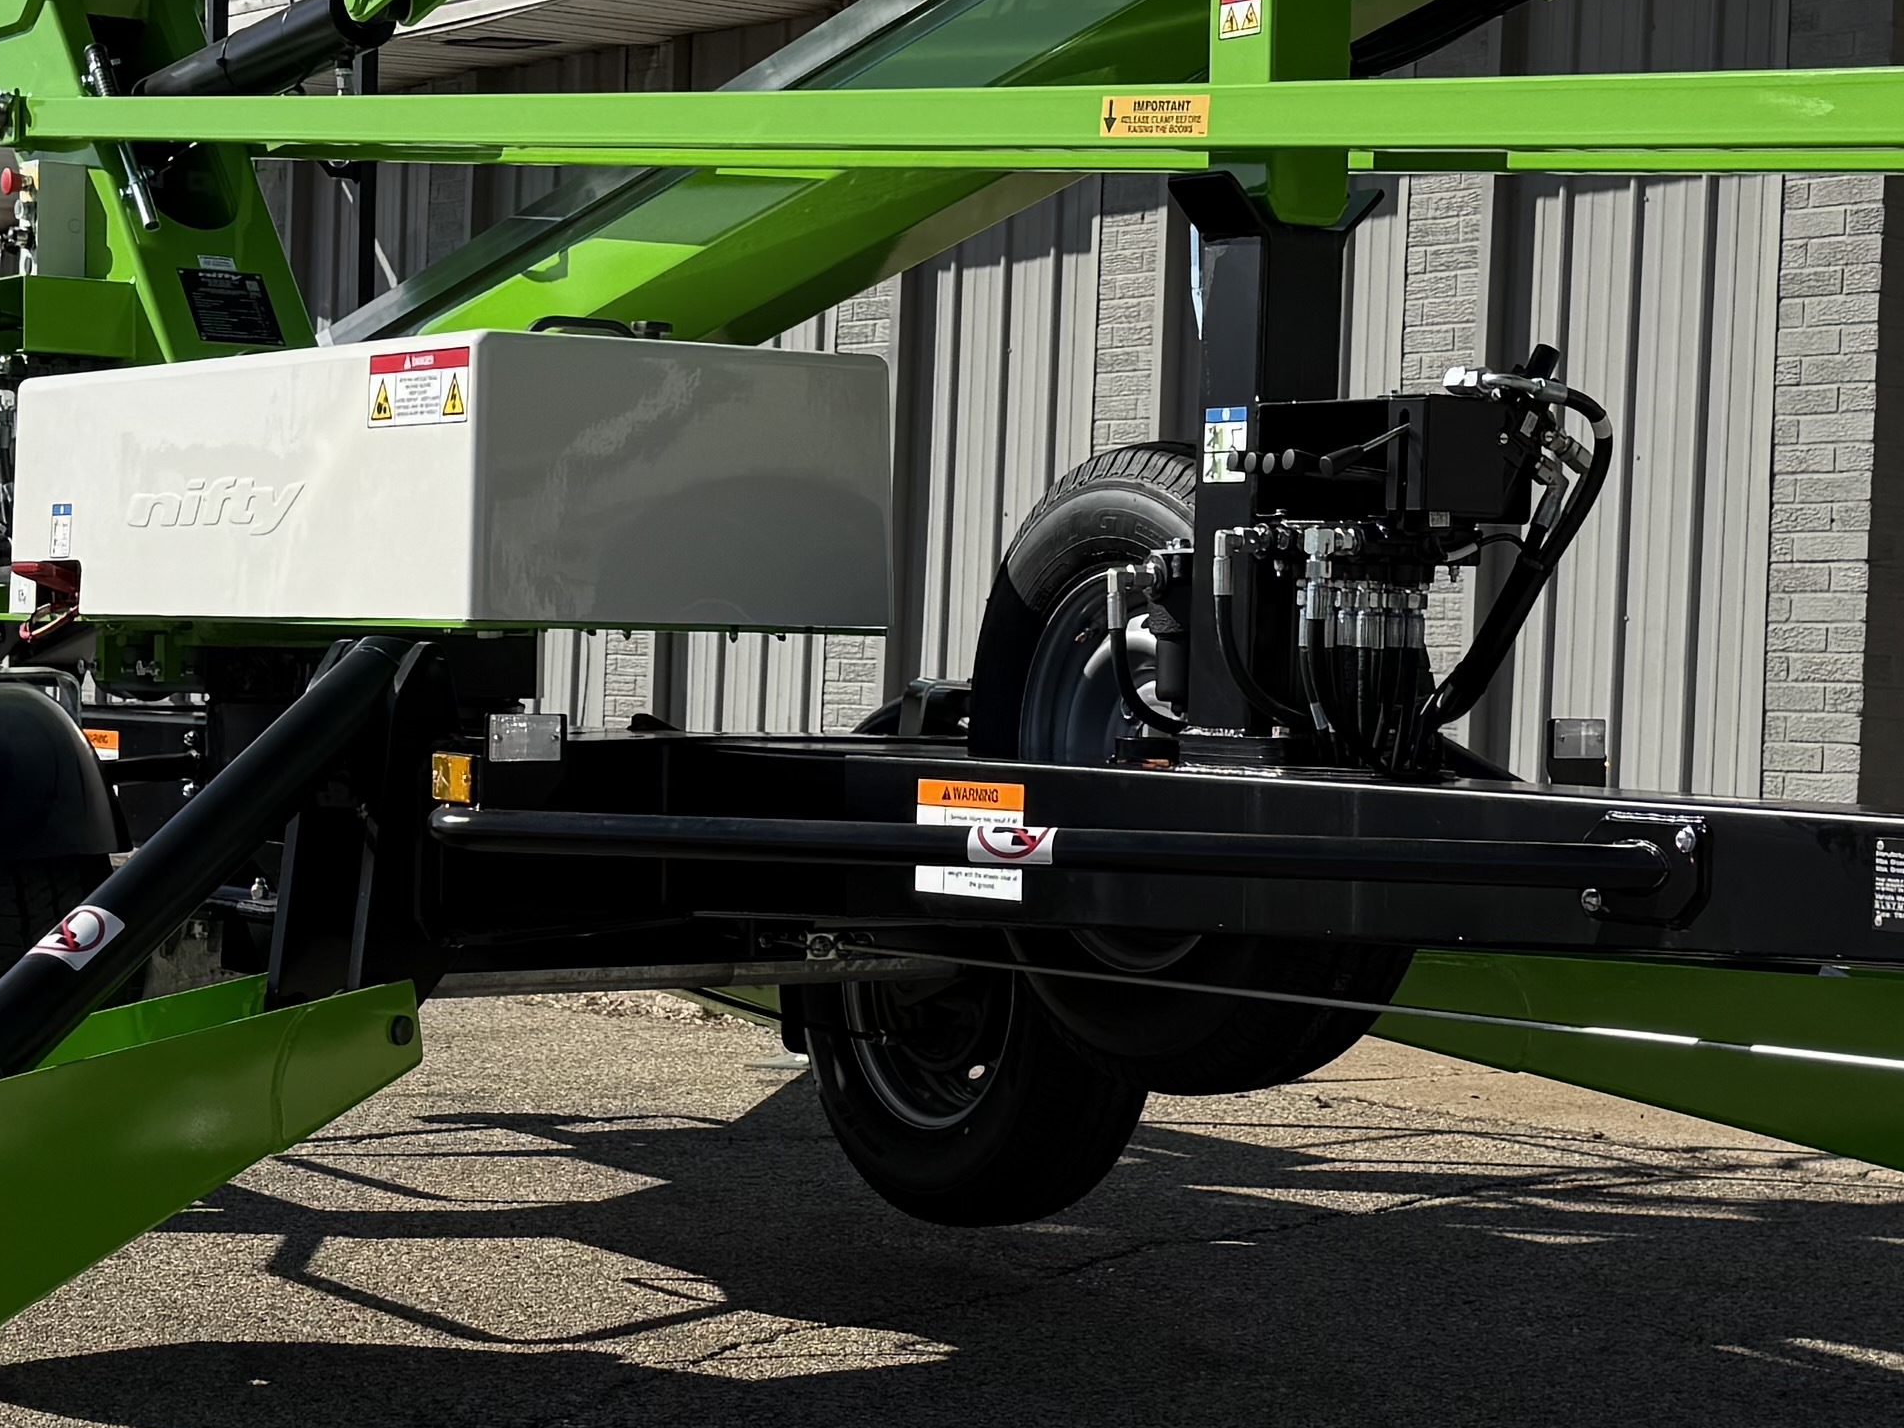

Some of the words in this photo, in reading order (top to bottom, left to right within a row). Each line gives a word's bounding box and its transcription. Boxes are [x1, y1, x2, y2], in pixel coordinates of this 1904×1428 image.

[1133, 100, 1192, 112] IMPORTANT
[127, 476, 305, 535] nifty
[953, 786, 999, 803] WARNING
